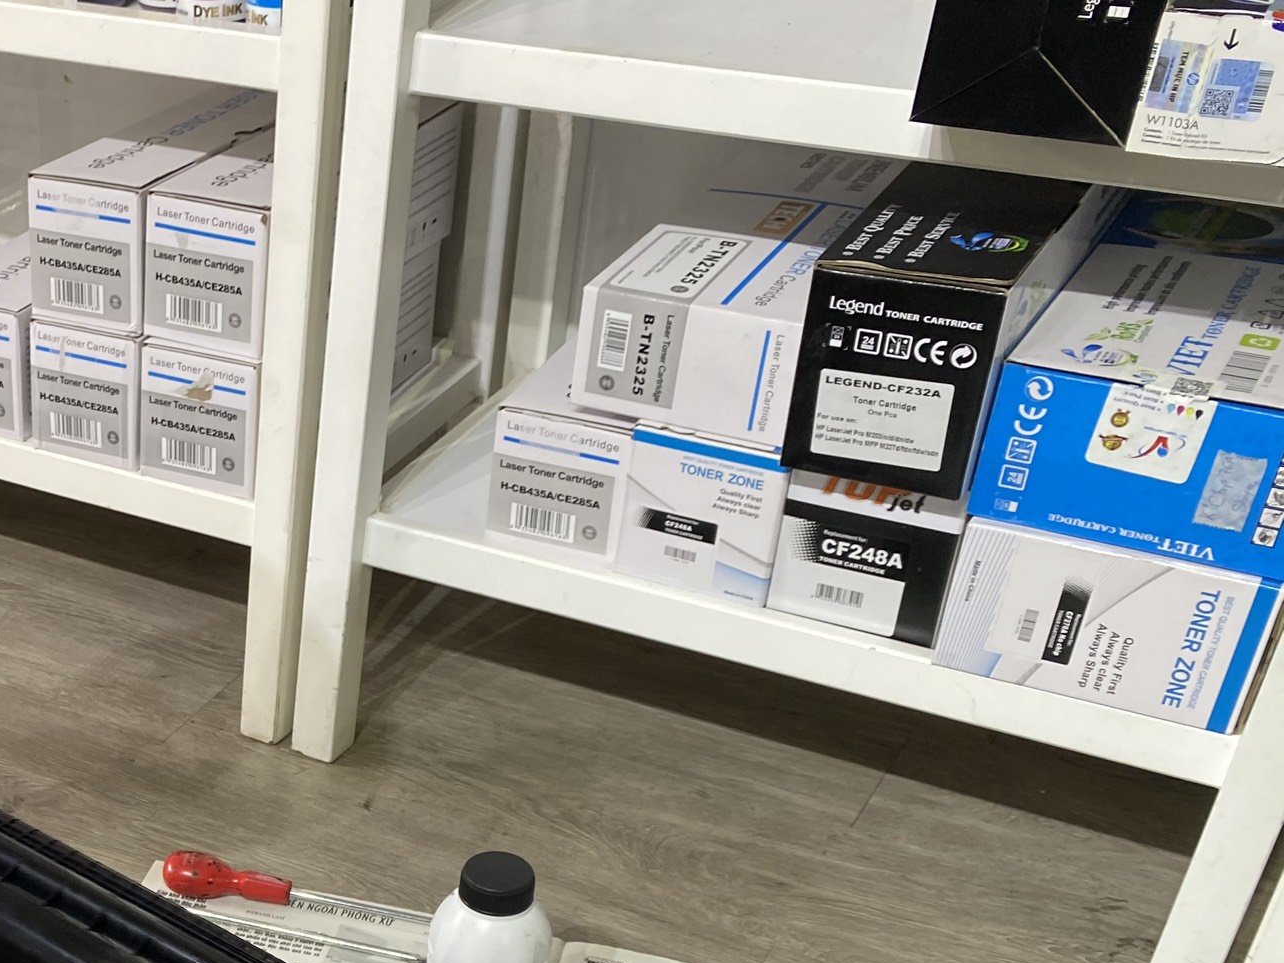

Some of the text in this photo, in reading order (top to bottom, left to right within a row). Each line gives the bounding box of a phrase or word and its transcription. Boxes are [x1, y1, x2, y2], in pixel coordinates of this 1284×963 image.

[193, 5, 219, 18] DYE
[1178, 51, 1190, 67] TEM
[1146, 114, 1199, 130] W1103A
[156, 207, 255, 234] Laser Toner Cartridge
[36, 234, 123, 257] Laser Toner Cartridge
[845, 232, 873, 252] BEST
[876, 235, 901, 255] BEST
[908, 239, 932, 259] BEST
[39, 256, 122, 278] H-CB435A/CE285A
[153, 249, 245, 274] Laser Toner Cartridge
[681, 240, 738, 286] B-TN2325
[155, 272, 243, 296] H-CB435A/CE285A
[828, 295, 984, 331] Legend TONER CARTRIDGE
[150, 356, 201, 376] Laser Toner
[632, 313, 656, 396] B-TN2325
[652, 314, 676, 402] Laser Toner Cartridge
[1165, 336, 1215, 376] VIET
[37, 371, 120, 395] Laser Toner Cartridge
[757, 334, 786, 432] Laser Toner Cartridge
[825, 375, 942, 398] LEGEND-CF232A
[39, 392, 119, 416] H-CB435A/CE285A
[148, 395, 238, 421] Laser Toner Cartridge
[853, 395, 917, 412] Toner Cartridge
[151, 416, 236, 441] H-CB435A/CE285A
[499, 459, 605, 489] Laser Toner Cartridge
[680, 462, 724, 483] TONER
[727, 471, 765, 492] ZONE
[500, 480, 601, 510] H-CB435A/CE285A
[720, 487, 744, 501] Quality
[887, 493, 927, 514] jet
[1047, 513, 1216, 561] VIET TONER CARTRIDGE
[819, 555, 886, 575] TONER CARTRIDGE
[821, 538, 903, 569] CF248A
[1181, 590, 1221, 653] TONER
[1077, 623, 1108, 689] Always Sharp
[1092, 631, 1121, 692] Always clear
[1106, 637, 1135, 695] Quality First
[1161, 656, 1195, 709] ZONE
